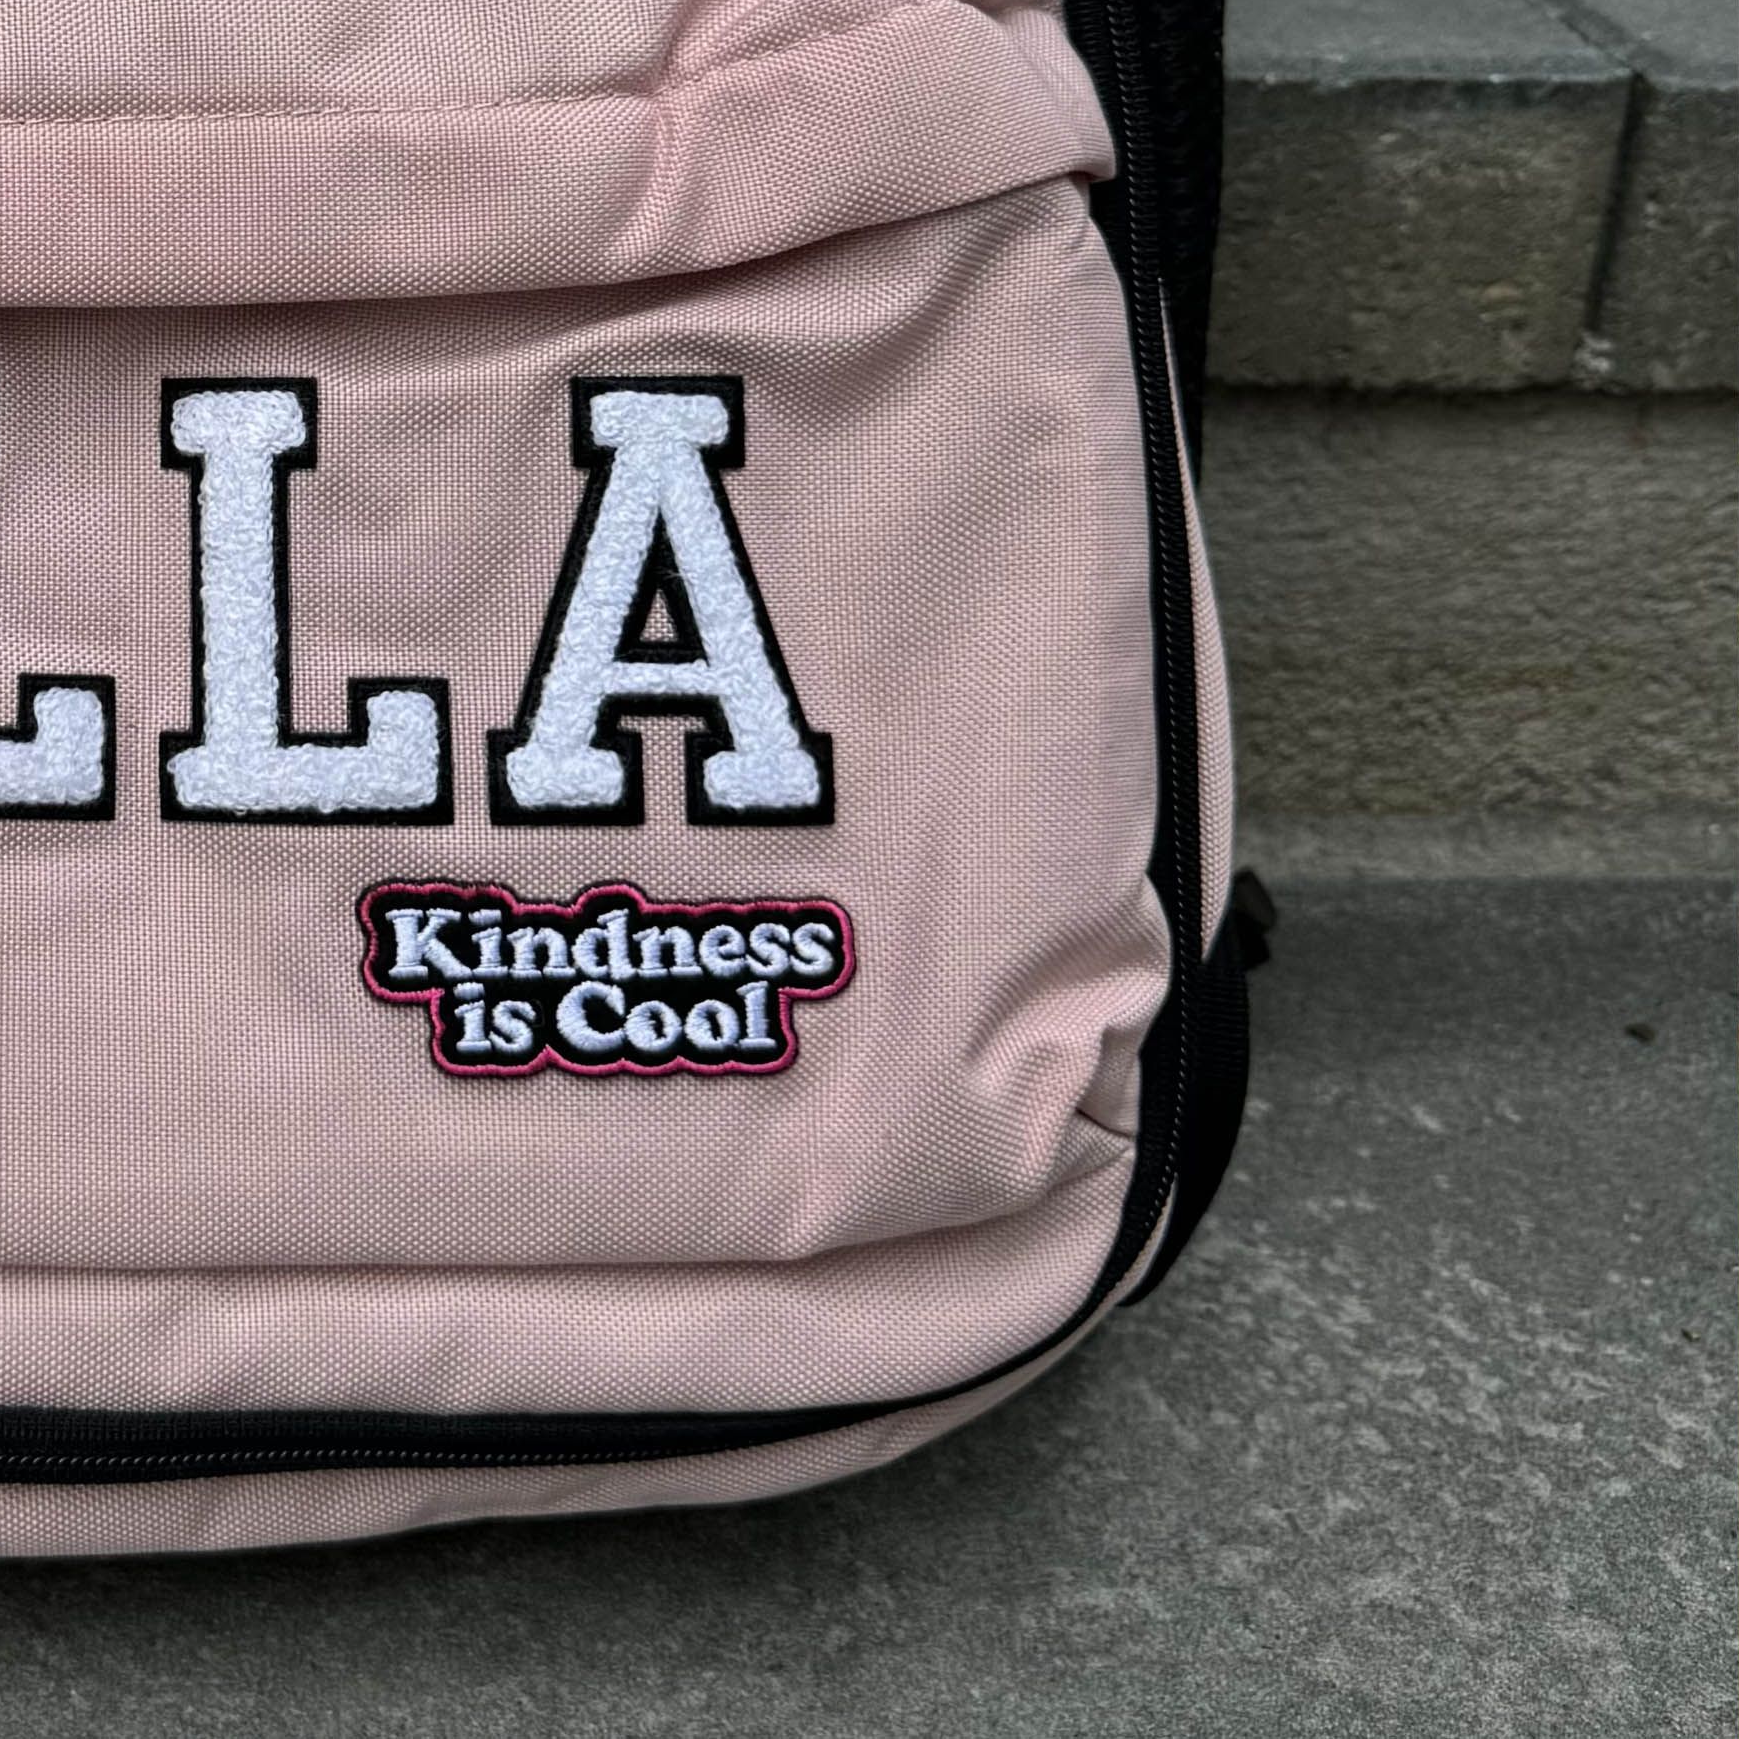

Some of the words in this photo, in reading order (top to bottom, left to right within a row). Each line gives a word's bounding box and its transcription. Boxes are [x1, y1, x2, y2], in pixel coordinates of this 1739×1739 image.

[384, 907, 835, 981] Kindness
[454, 982, 538, 1053] is
[557, 980, 778, 1053] Cool
